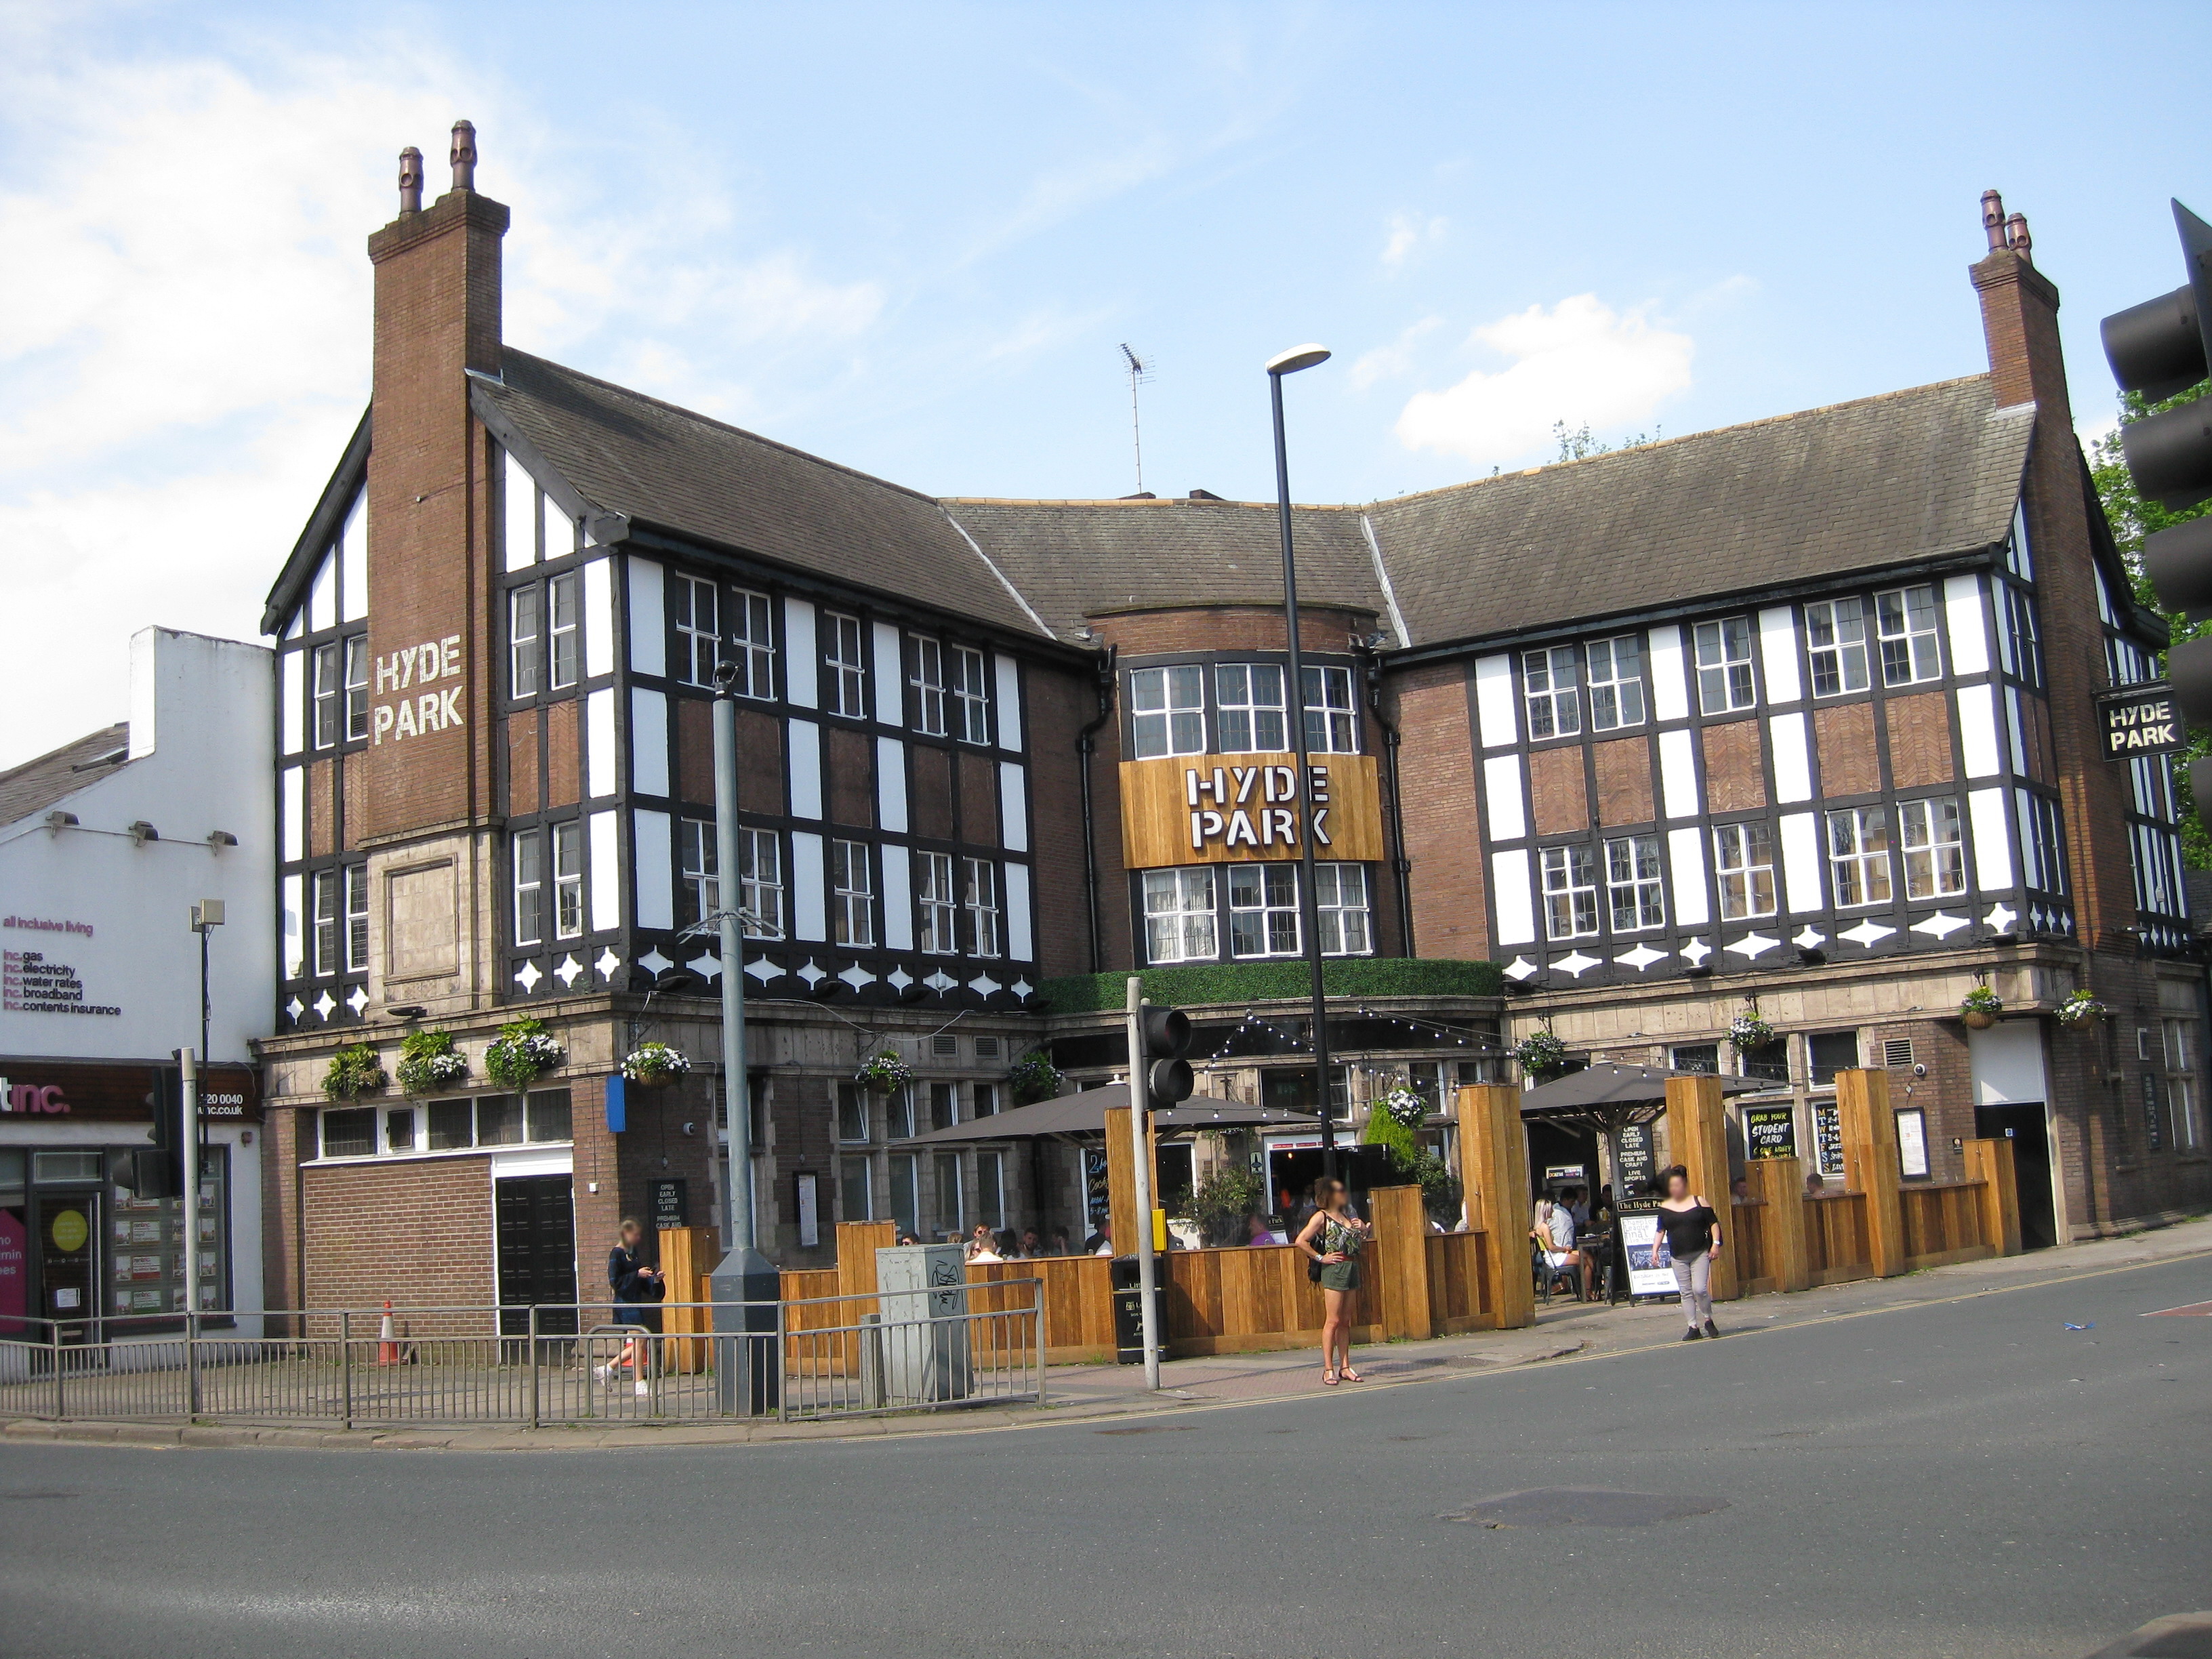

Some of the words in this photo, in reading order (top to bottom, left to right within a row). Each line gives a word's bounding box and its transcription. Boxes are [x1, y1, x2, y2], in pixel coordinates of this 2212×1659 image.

[377, 634, 461, 695] HYDE
[375, 685, 464, 745] PARK
[2109, 701, 2171, 728] HYDE
[2110, 723, 2176, 752] PARK
[1186, 765, 1330, 806] HYDE
[1190, 808, 1332, 848] PARK
[3, 916, 16, 927] all
[18, 917, 64, 931] inclusive
[66, 920, 94, 937] living
[55, 978, 83, 989] rates
[70, 1002, 121, 1015] insurance
[220, 1094, 243, 1105] 0040
[1750, 1113, 1768, 1124] GRAB
[1771, 1112, 1787, 1122] YOUR
[1818, 1107, 1826, 1117] M
[1818, 1116, 1826, 1125] T
[1751, 1122, 1790, 1138] STUDENT
[1819, 1125, 1826, 1134] W
[1760, 1134, 1783, 1145] CARD
[1820, 1133, 1827, 1143] T
[1820, 1143, 1826, 1152] F
[1821, 1151, 1828, 1163] S
[1088, 1155, 1099, 1174] 2
[1823, 1162, 1830, 1172] S
[1633, 1201, 1651, 1210] Hyde
